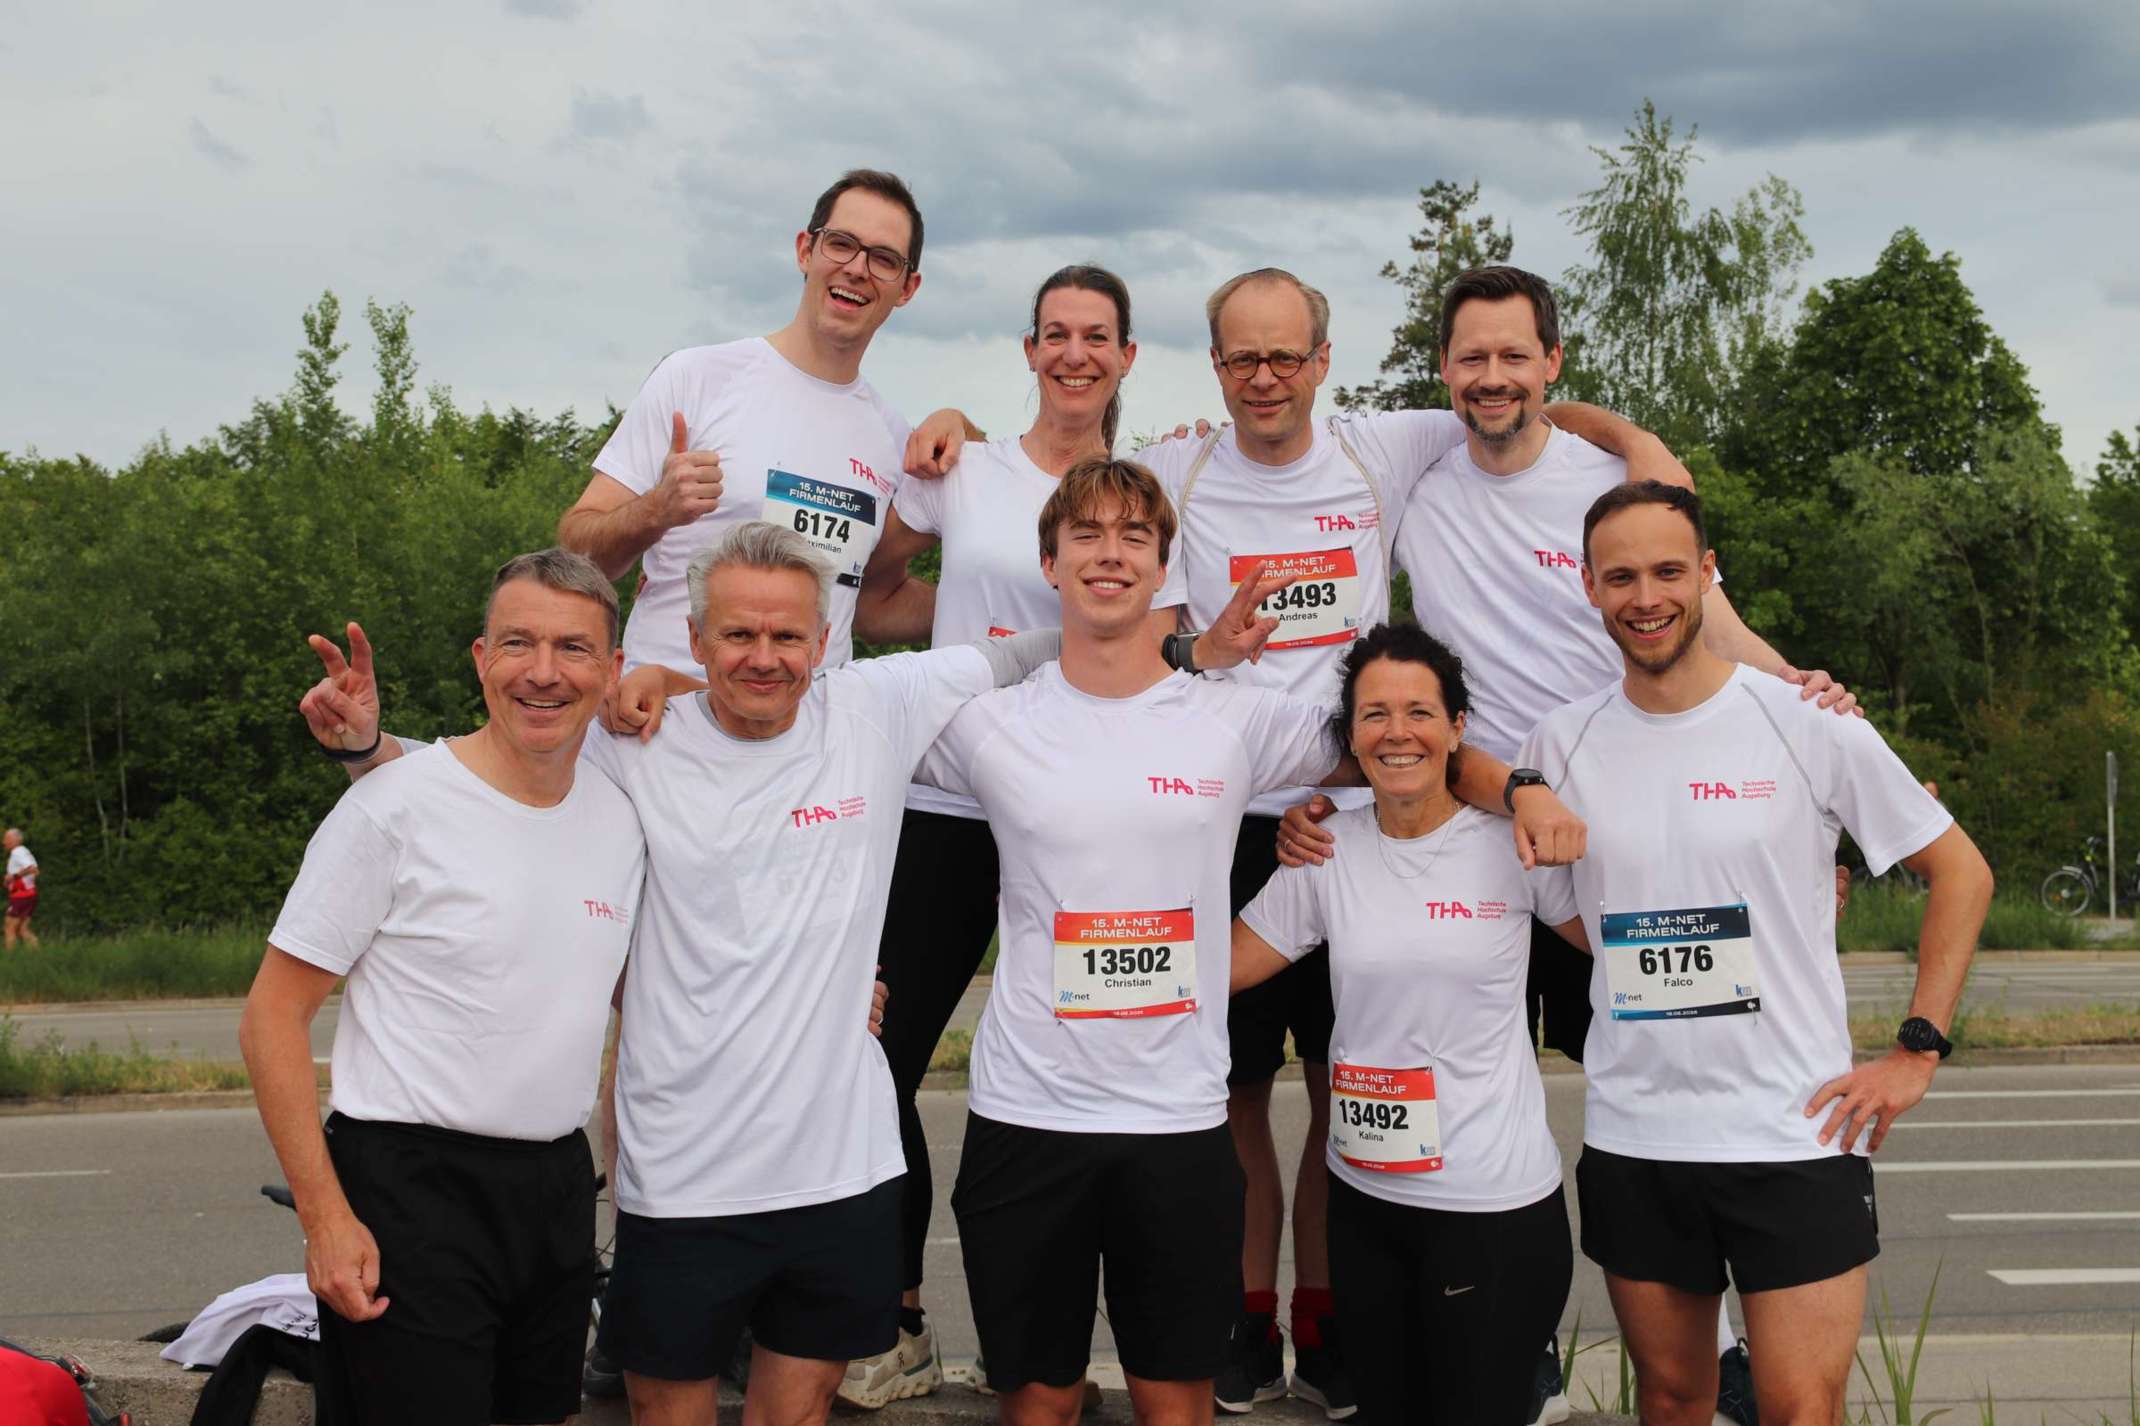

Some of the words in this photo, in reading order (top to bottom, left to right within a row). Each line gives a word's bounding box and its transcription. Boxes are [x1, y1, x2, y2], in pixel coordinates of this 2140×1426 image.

[789, 488, 862, 513] FIRMENLAUF
[816, 486, 855, 502] M-NET
[793, 508, 850, 544] 6174
[808, 540, 842, 554] ximilian
[1282, 556, 1326, 568] M-NET
[1262, 564, 1337, 578] RMENLAUF
[1279, 612, 1318, 622] Andreas
[1113, 917, 1162, 927] M-NET
[1657, 914, 1706, 926] M-NET
[1080, 926, 1173, 939] FIRMENLAUF
[1626, 923, 1720, 939] FIRMENLAUF
[1082, 946, 1171, 975] 13502
[1639, 945, 1714, 976] 6176
[1104, 978, 1152, 988] Christian
[1663, 978, 1694, 988] Falco
[1356, 1072, 1394, 1084] M-NET
[1335, 1079, 1407, 1095] FIRMENLAUF
[1339, 1098, 1409, 1130] 13492
[1358, 1130, 1384, 1142] Kalina
